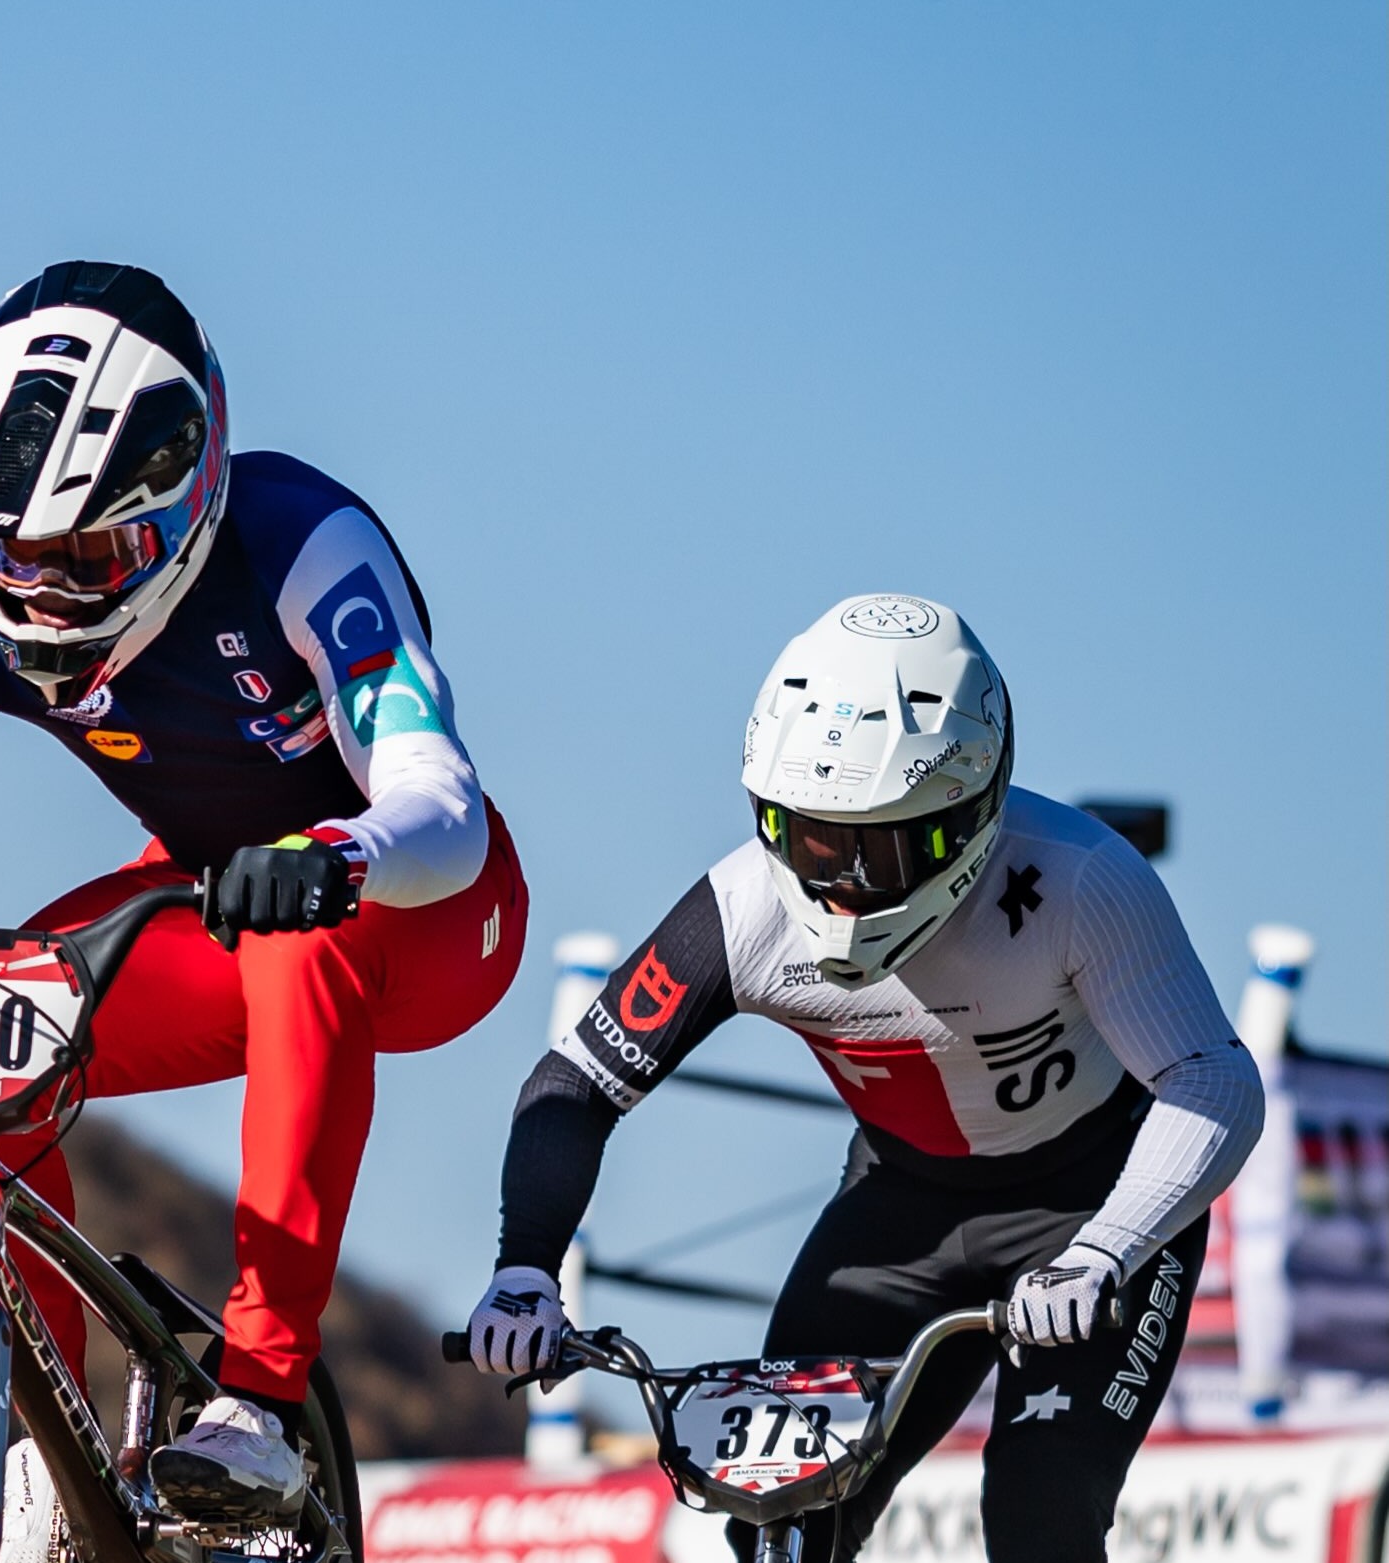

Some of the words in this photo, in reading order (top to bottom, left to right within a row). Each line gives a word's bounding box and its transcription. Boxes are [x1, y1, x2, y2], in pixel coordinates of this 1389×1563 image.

[587, 1000, 659, 1076] TUDOR
[760, 1359, 796, 1373] box
[1102, 1250, 1183, 1421] EVIDEN
[716, 1404, 831, 1461] 373
